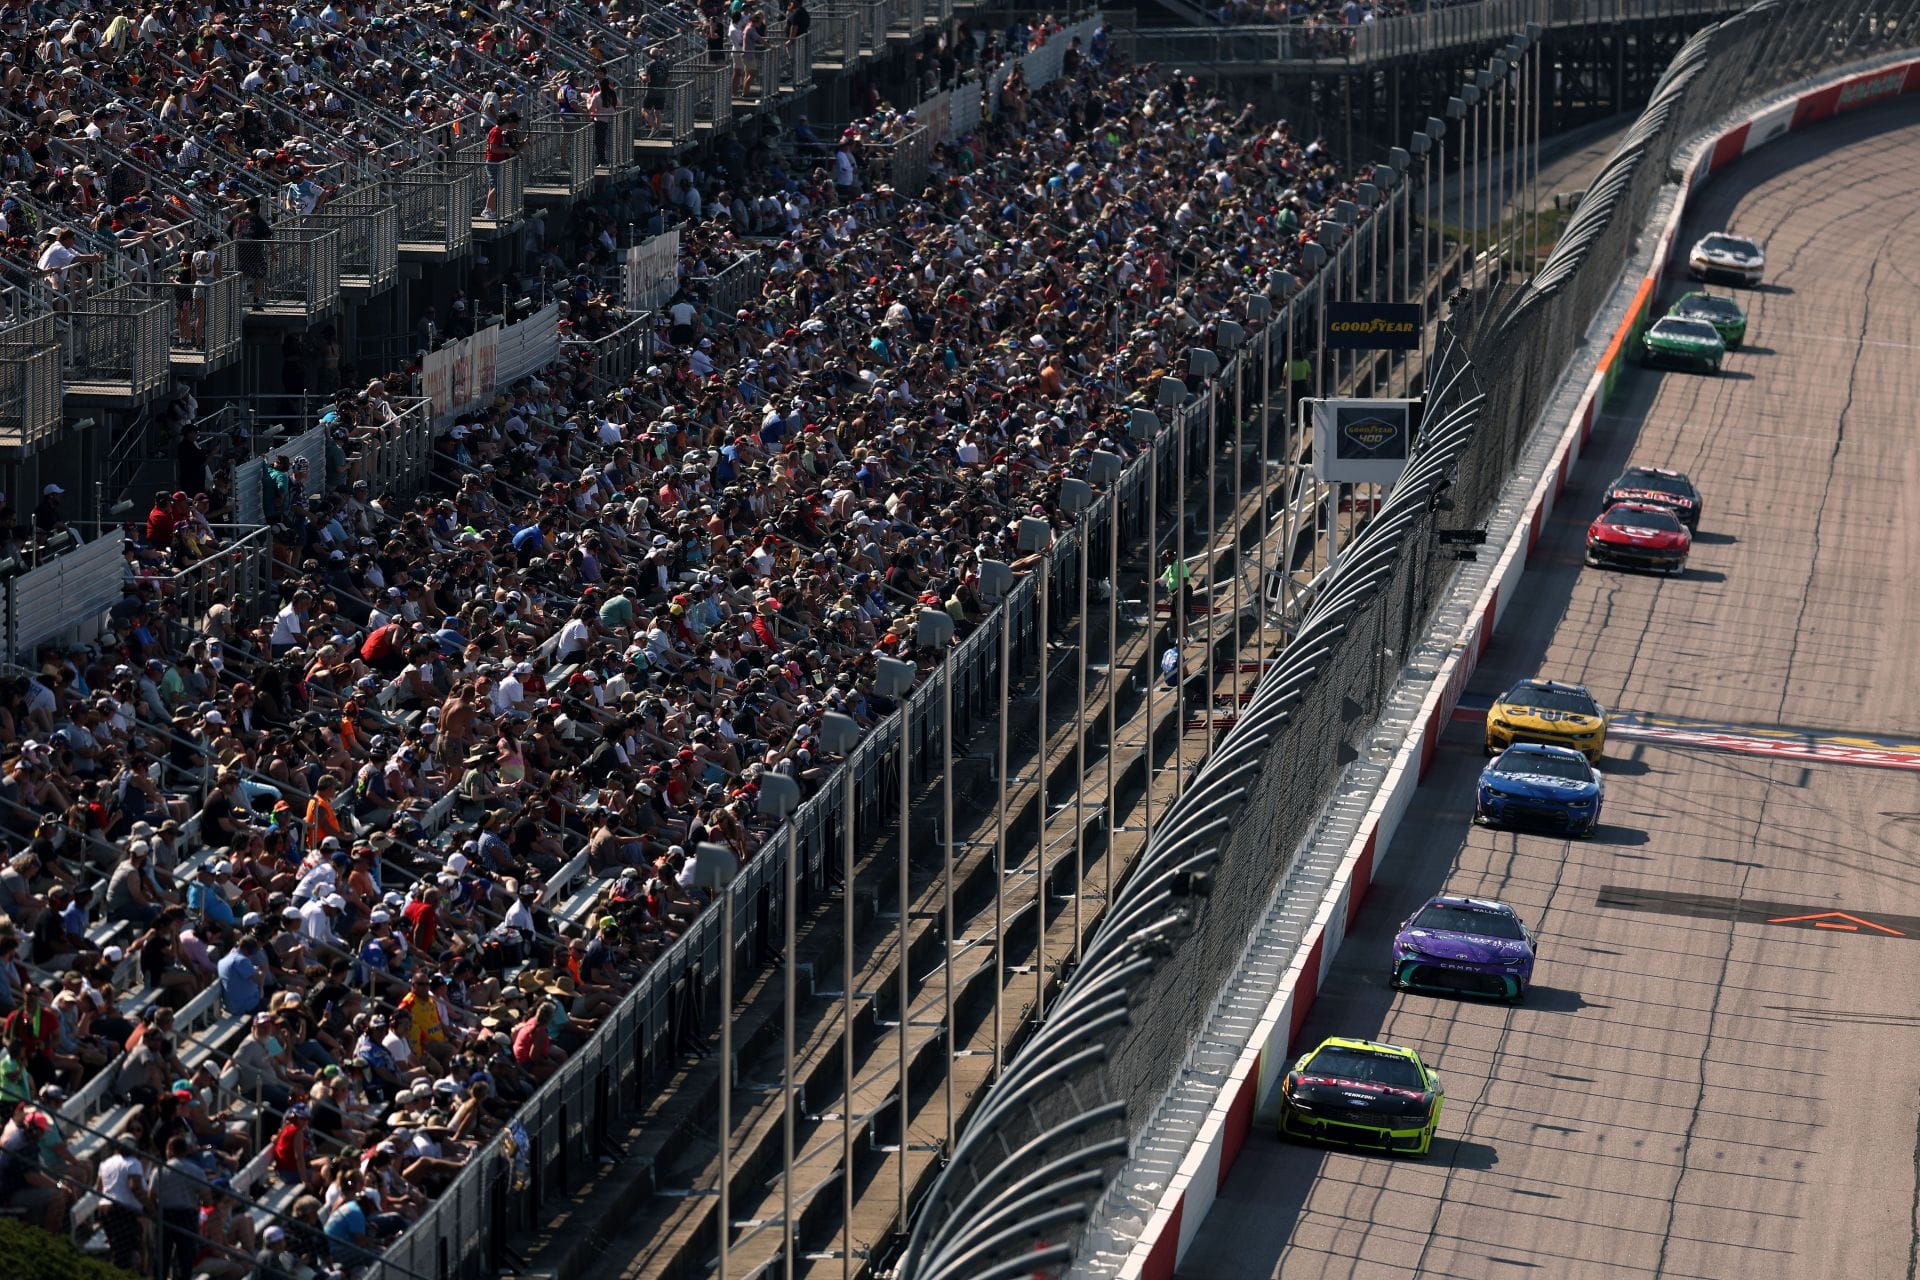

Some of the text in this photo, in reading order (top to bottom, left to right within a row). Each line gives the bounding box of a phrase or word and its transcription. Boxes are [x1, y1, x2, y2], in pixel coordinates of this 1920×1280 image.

[1330, 318, 1414, 333] GOODYEAR
[1348, 424, 1393, 433] GOODYEAR
[1359, 434, 1383, 443] 400
[1473, 908, 1509, 916] WALLACE
[1440, 963, 1481, 972] CAMRY
[1343, 1091, 1376, 1100] PENNZOIL
